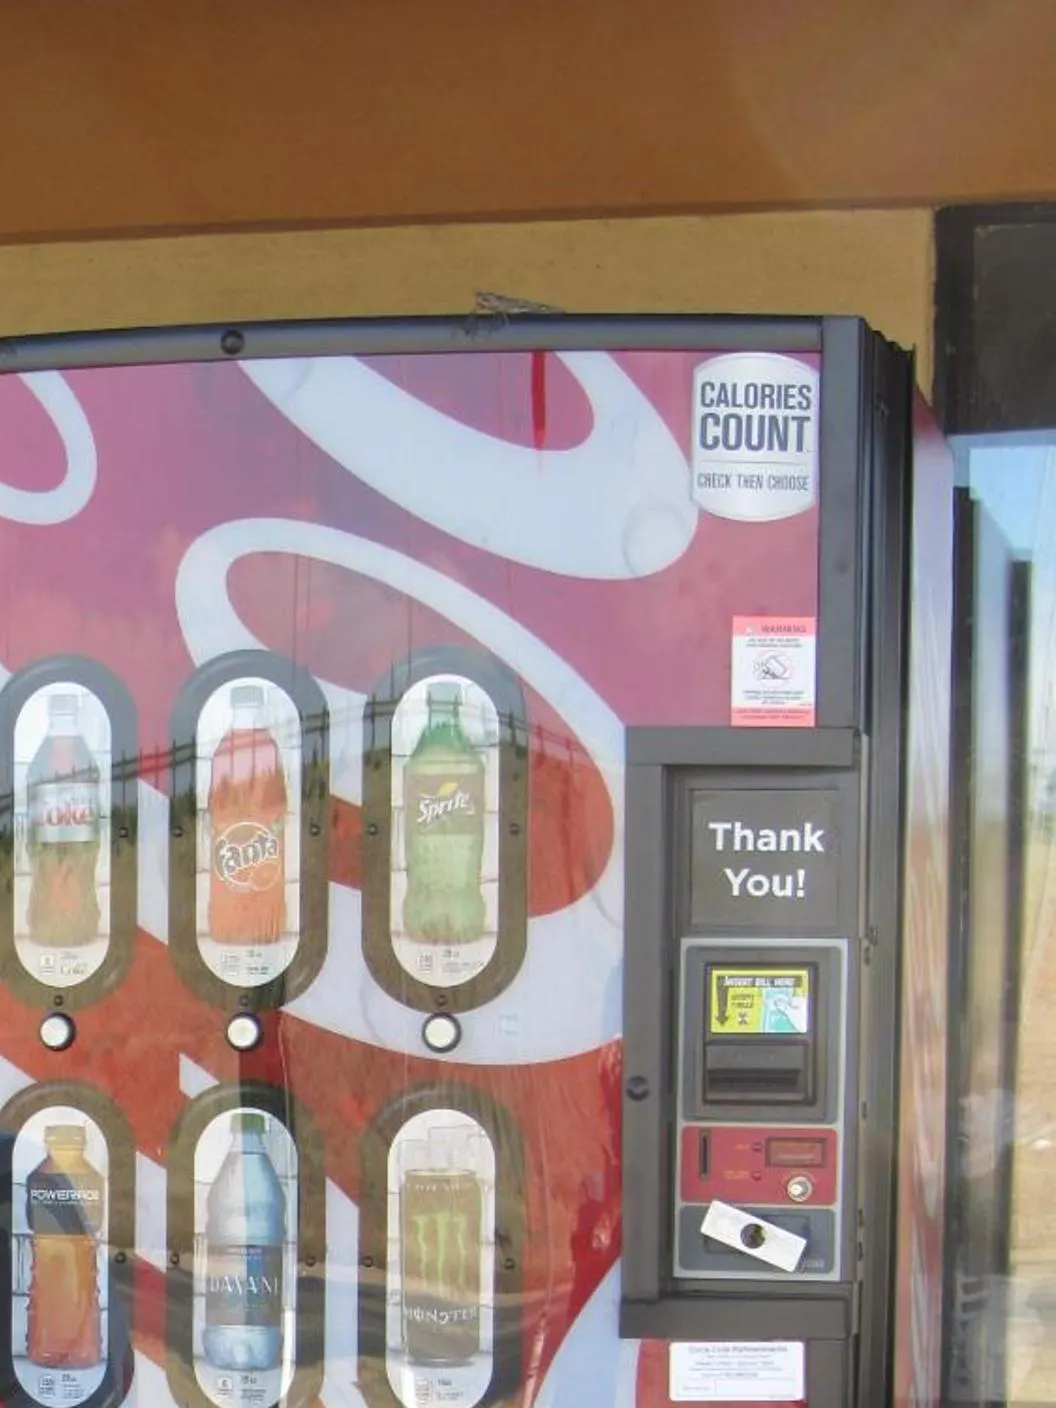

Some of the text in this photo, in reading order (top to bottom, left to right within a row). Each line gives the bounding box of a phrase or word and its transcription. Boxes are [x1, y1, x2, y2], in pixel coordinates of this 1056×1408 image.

[700, 381, 812, 410] CALORIES
[700, 412, 811, 453] COUNT
[697, 473, 810, 491] CHECK THEN CHOOSE
[417, 790, 470, 824] Sprite
[708, 822, 825, 851] Thank
[724, 868, 806, 898] You!
